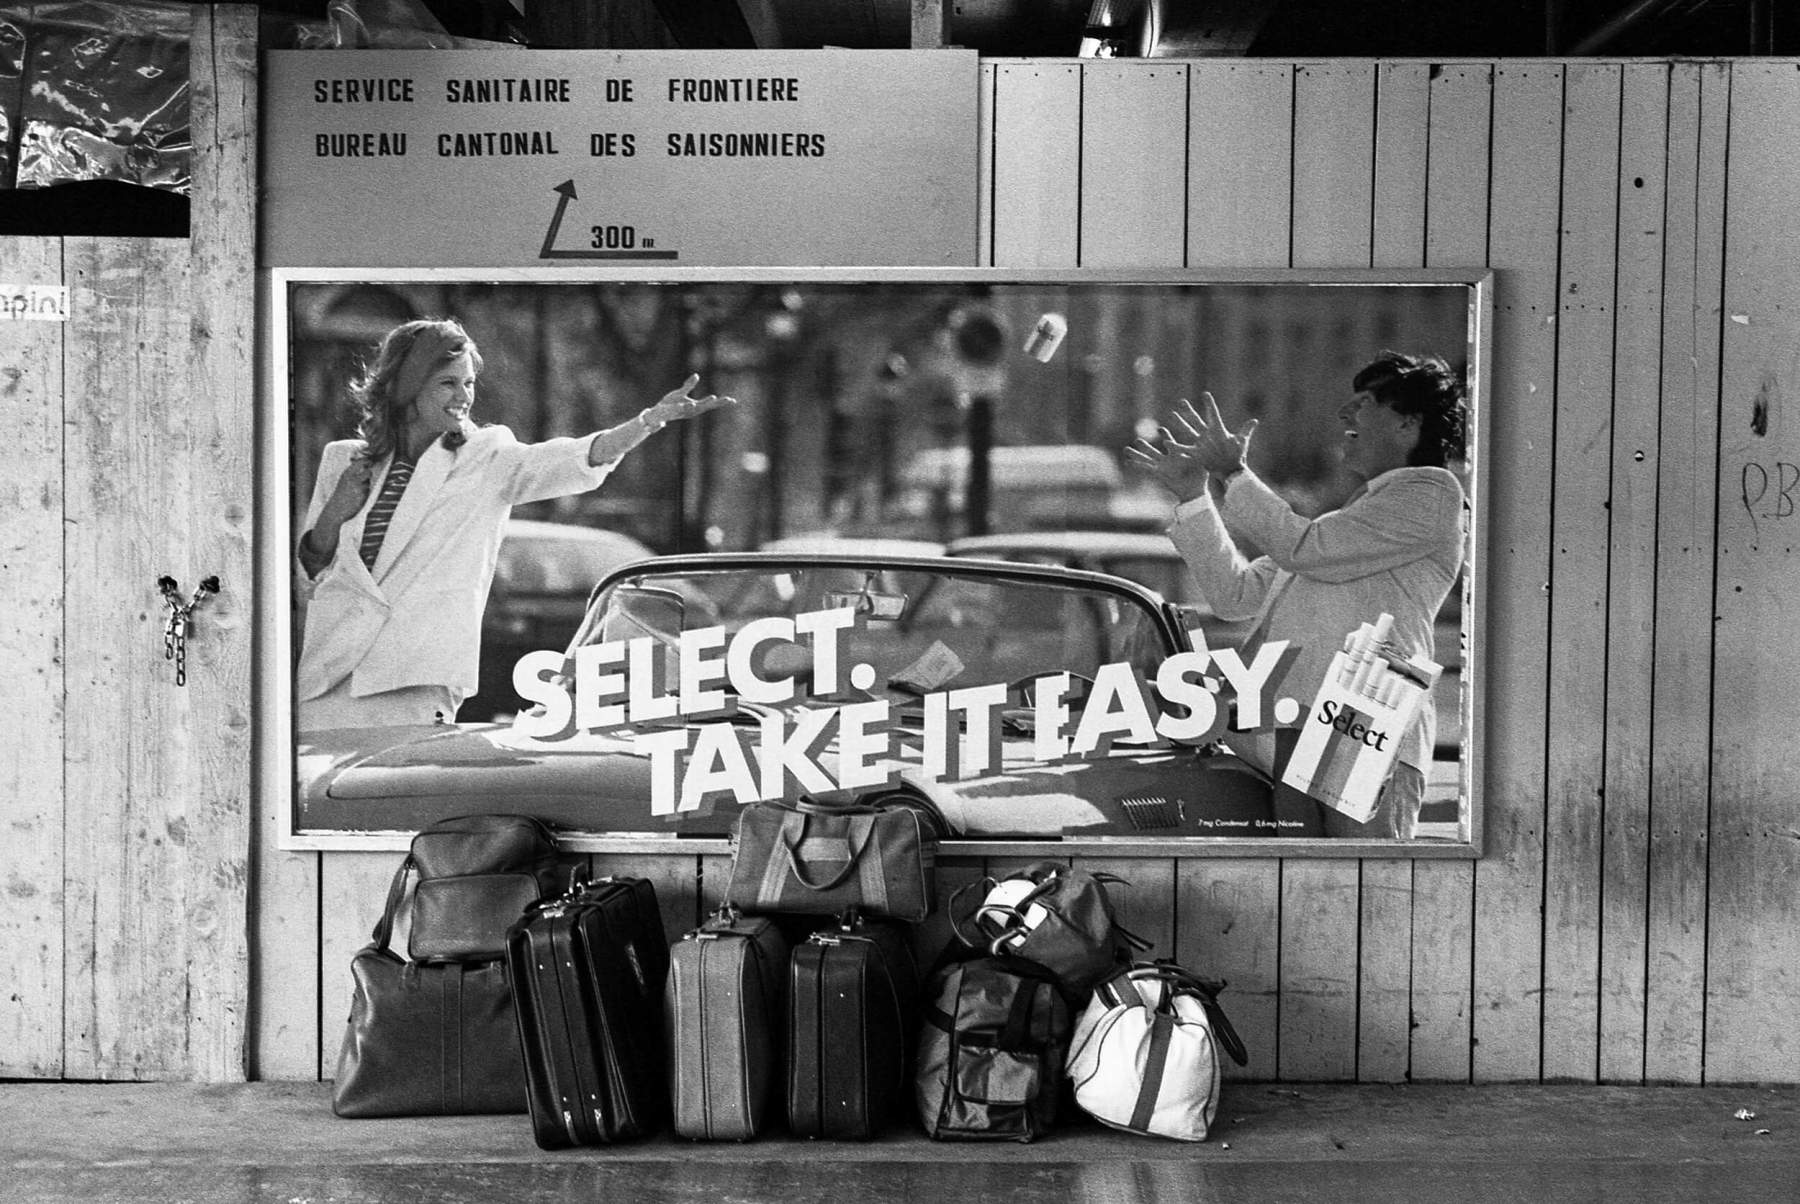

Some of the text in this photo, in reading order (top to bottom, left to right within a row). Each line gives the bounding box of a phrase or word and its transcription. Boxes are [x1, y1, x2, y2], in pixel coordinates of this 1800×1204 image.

[314, 78, 798, 104] SERVICE SANITAIRE DE FRONTIERE
[315, 131, 825, 158] BUREAU CANTONAL DES SAISONNIERS
[591, 225, 635, 249] 300
[512, 607, 876, 737] SELECT.
[634, 640, 1299, 816] TAKE IT EASY.
[1318, 700, 1389, 752] Select
